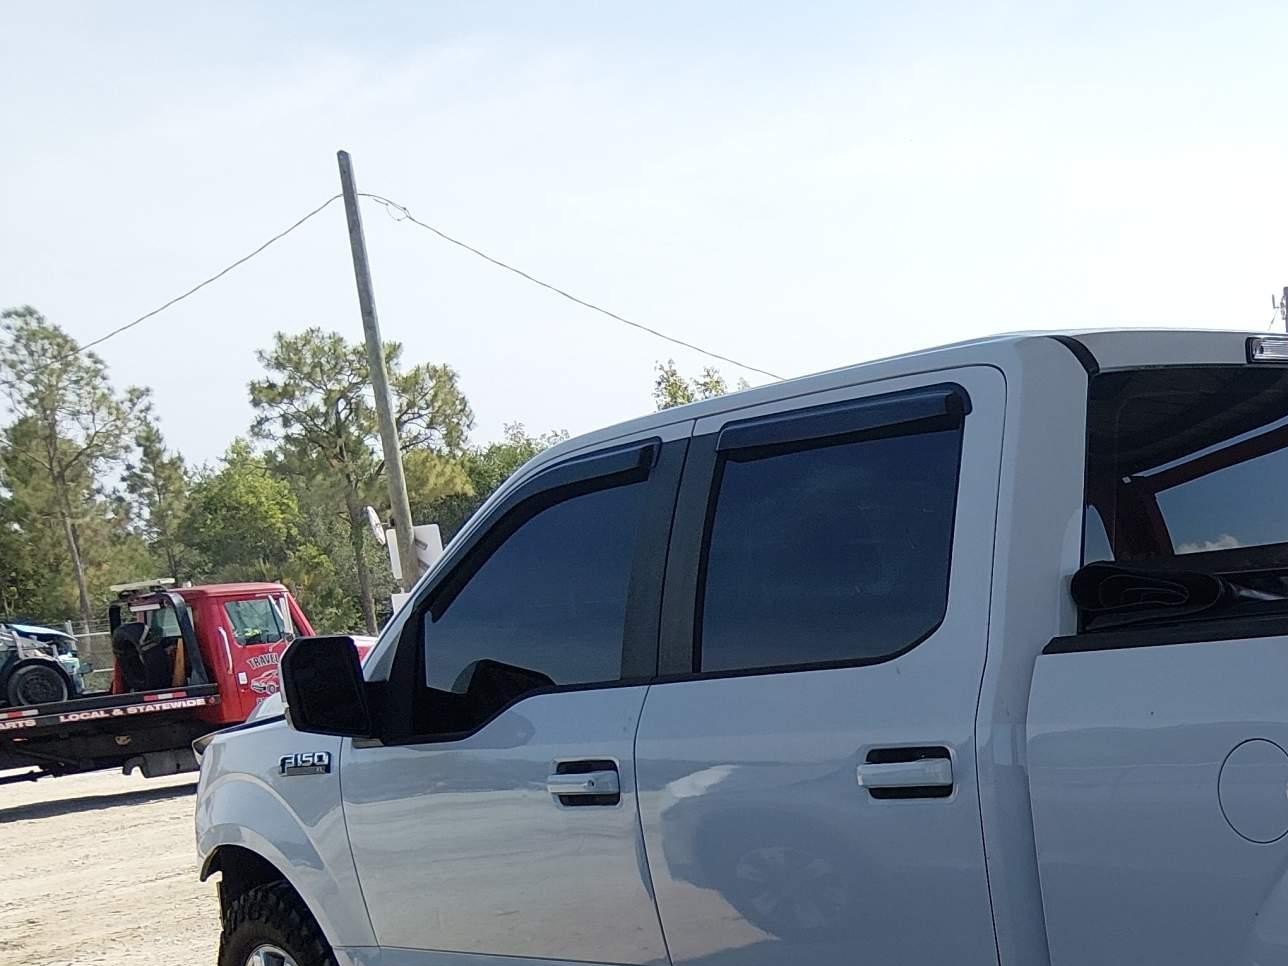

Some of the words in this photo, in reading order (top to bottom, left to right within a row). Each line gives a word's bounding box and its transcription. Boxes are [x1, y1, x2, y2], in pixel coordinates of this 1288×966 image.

[59, 710, 109, 723] LOCAL
[112, 708, 124, 716] &
[127, 698, 206, 713] STATEWIDE
